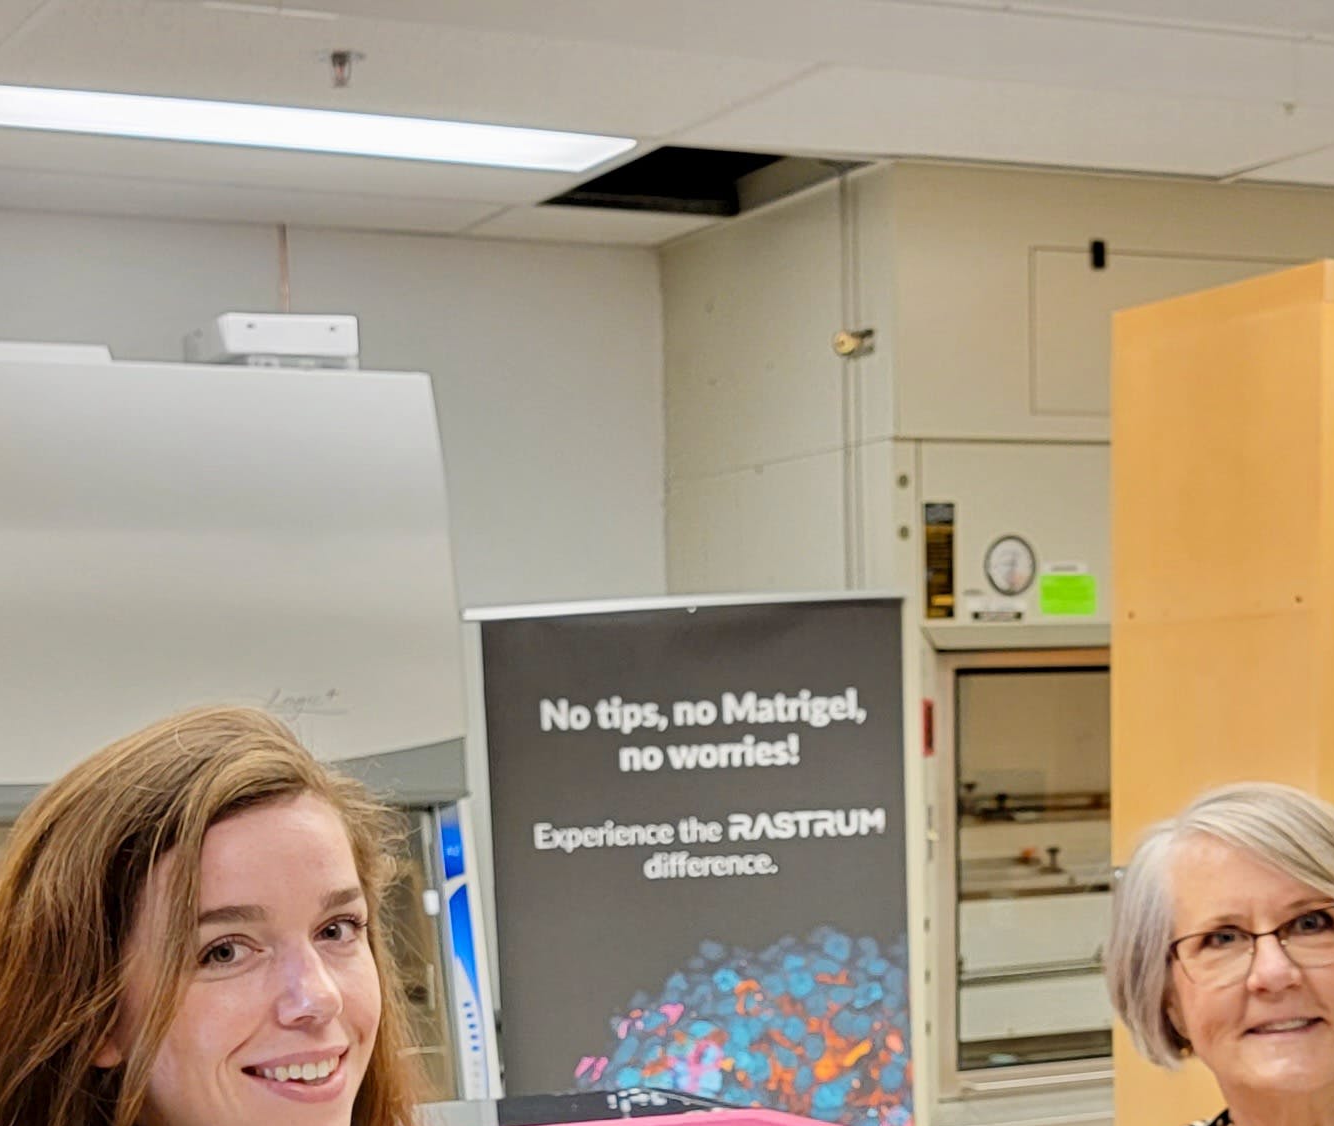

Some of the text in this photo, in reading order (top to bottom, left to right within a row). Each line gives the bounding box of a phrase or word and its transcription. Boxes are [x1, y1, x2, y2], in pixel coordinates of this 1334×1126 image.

[540, 687, 867, 734] No tips, no Matrigel,
[619, 733, 800, 772] no worries!
[533, 808, 886, 853] Experience the RASTRUM
[643, 851, 779, 879] difference.
